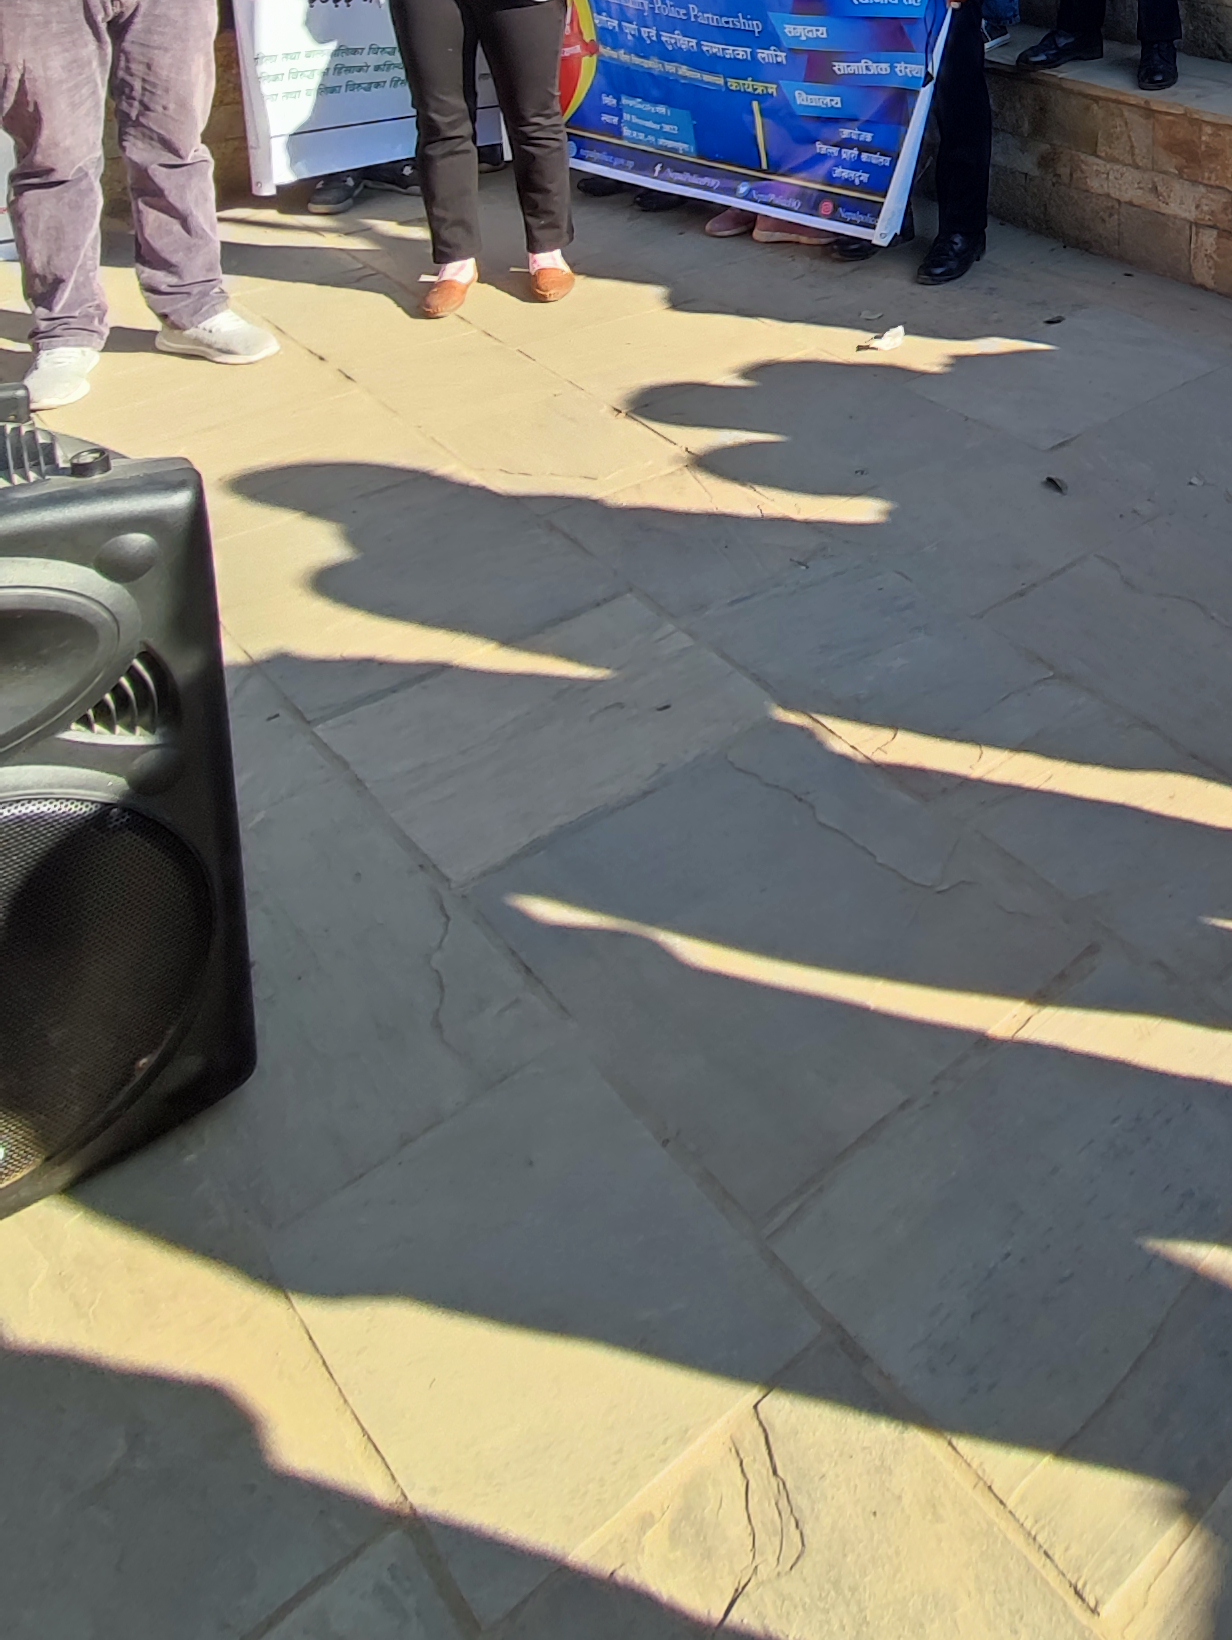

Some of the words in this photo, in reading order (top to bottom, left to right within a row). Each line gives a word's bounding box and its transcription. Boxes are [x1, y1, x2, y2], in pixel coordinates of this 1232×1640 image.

[688, 3, 763, 37] Partnership
[783, 24, 828, 40] समुदाय
[832, 58, 890, 75] सामाजिक
